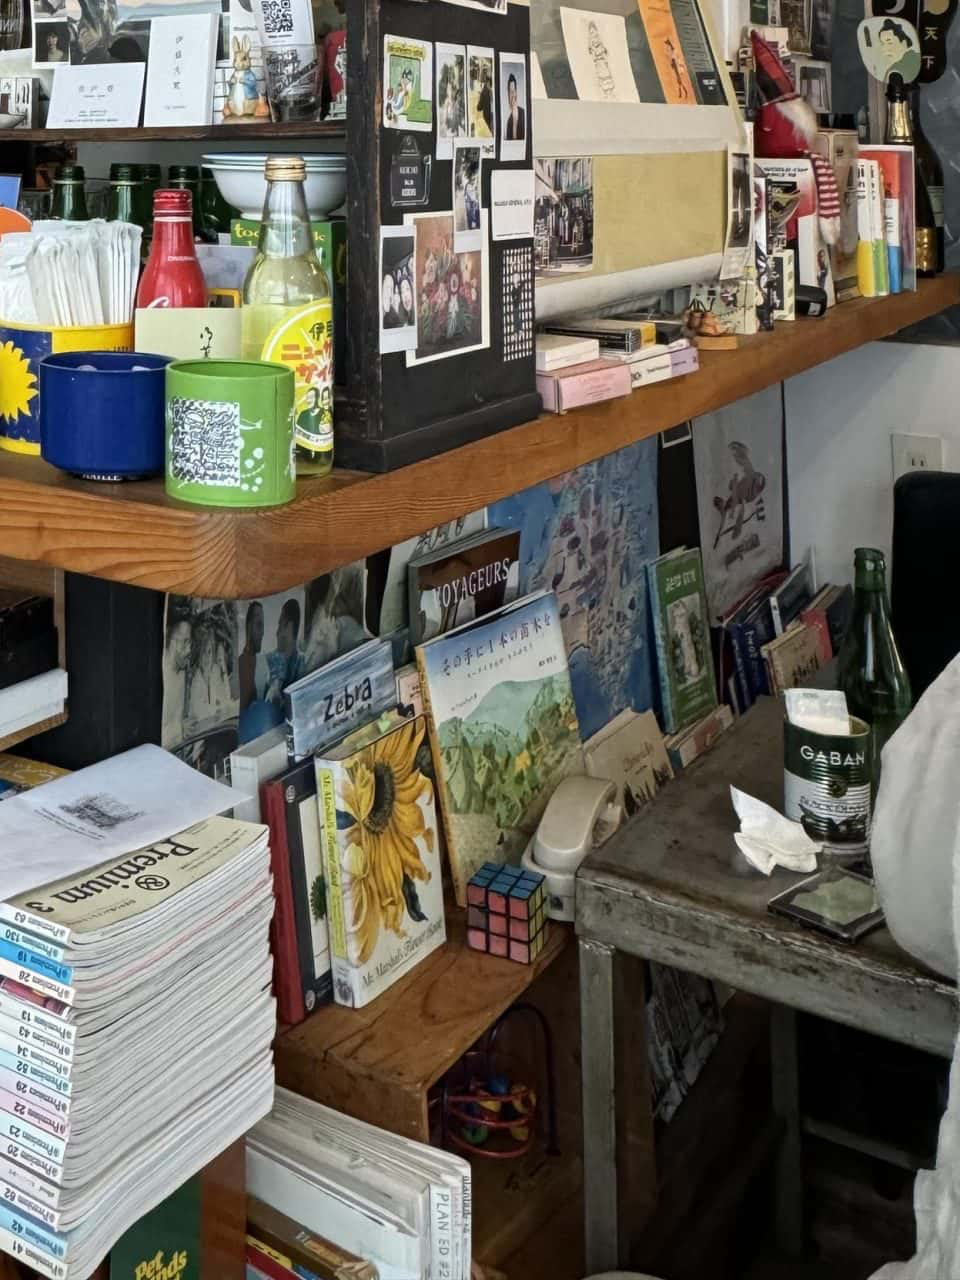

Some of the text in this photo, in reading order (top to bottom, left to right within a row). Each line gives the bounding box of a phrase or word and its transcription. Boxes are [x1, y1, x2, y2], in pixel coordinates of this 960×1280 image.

[922, 26, 938, 70] 天下
[431, 557, 511, 609] VOYAGEURS
[323, 675, 373, 722] Zebra
[800, 745, 865, 767] GABAN
[50, 838, 199, 904] Premium
